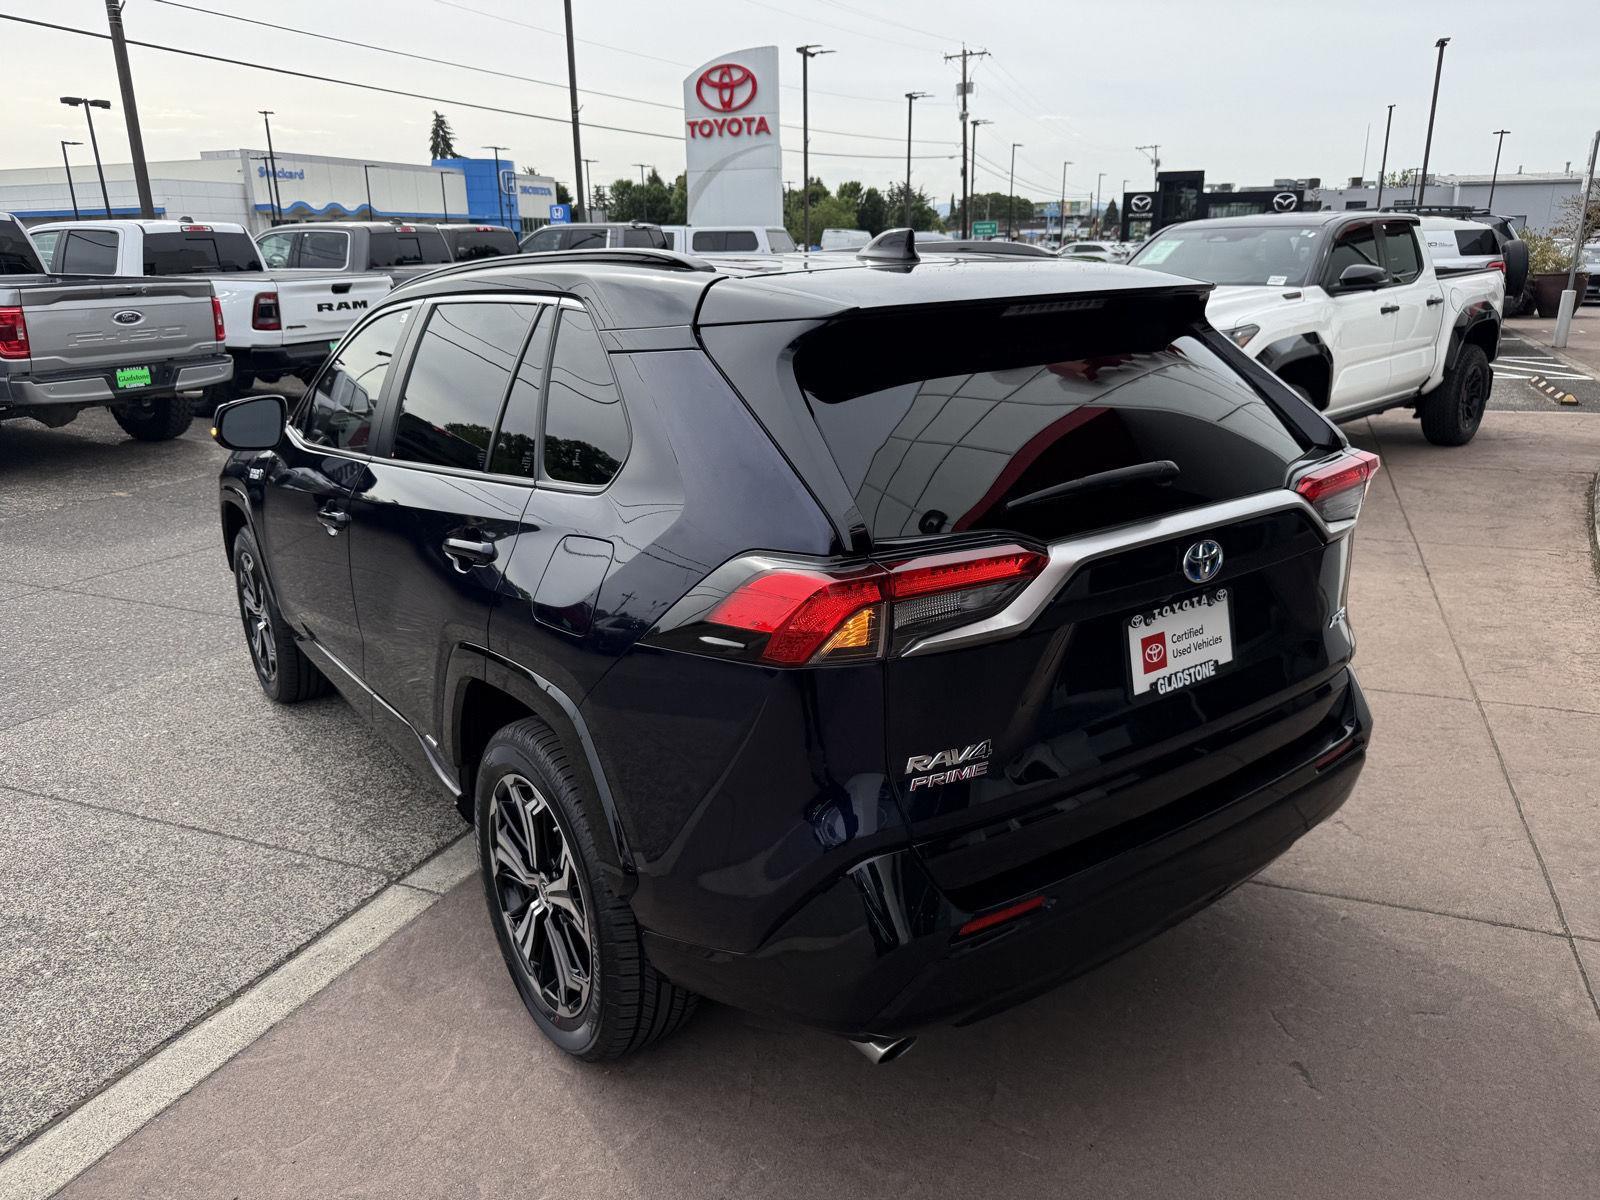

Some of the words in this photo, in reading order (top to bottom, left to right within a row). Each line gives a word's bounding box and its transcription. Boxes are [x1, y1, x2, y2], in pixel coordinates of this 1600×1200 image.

[686, 116, 771, 139] TOYOTA
[316, 300, 368, 312] RAM
[118, 374, 150, 383] Gladstone
[1153, 594, 1208, 620] TOYOTA
[1171, 624, 1204, 643] Certified
[1172, 645, 1192, 659] Used
[1193, 635, 1223, 651] Vehicles
[1157, 660, 1216, 694] GLADSTONE
[904, 739, 993, 774] RAV4
[909, 761, 989, 791] PRIME
